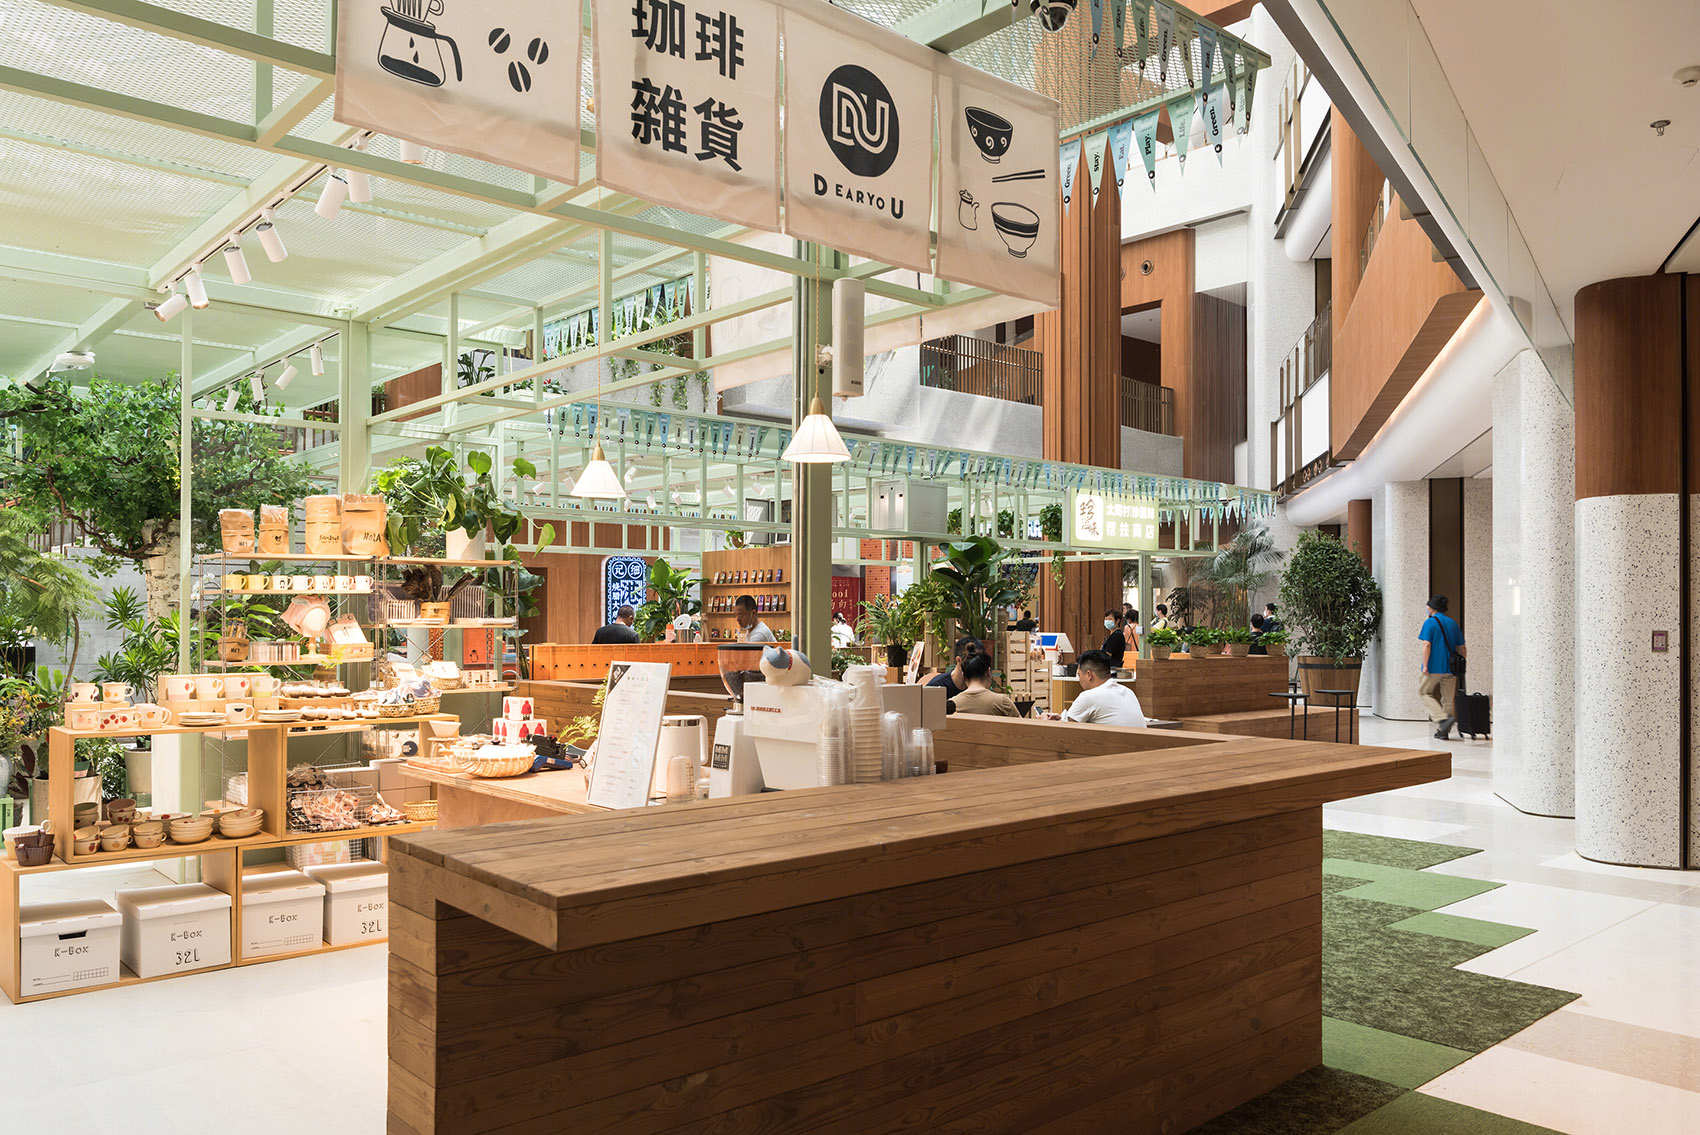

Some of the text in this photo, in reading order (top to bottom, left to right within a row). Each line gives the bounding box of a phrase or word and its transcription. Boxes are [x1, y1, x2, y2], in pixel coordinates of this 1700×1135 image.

[631, 0, 745, 80] 珈琲
[630, 78, 744, 172] 雜貨
[1209, 106, 1219, 136] Green.
[1064, 161, 1073, 188] Green.
[361, 919, 382, 935] 32L
[175, 949, 201, 966] 32L
